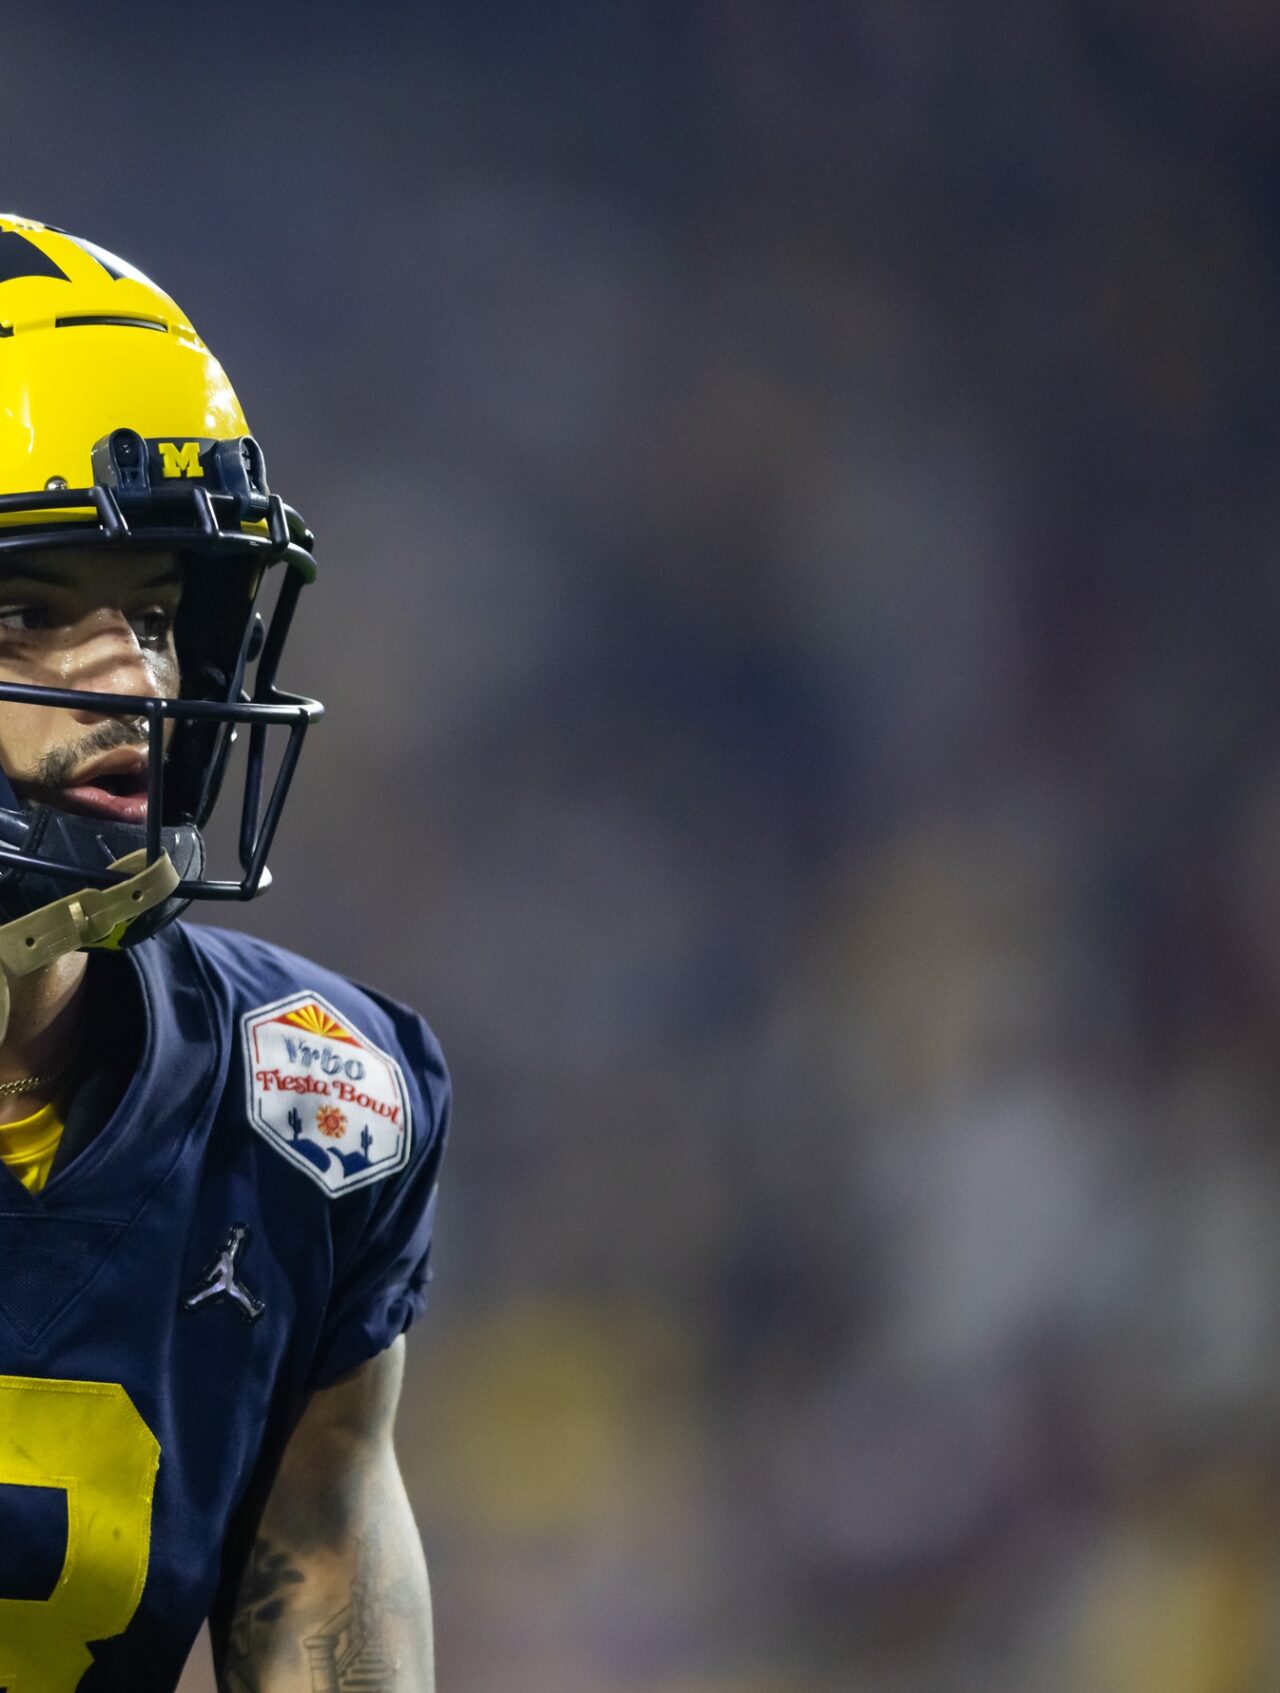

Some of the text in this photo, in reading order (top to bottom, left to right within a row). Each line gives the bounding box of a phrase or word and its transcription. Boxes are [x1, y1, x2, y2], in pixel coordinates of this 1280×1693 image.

[158, 442, 204, 478] M
[283, 1034, 366, 1081] Vrbo
[256, 1069, 400, 1125] Fiesta Bowl
